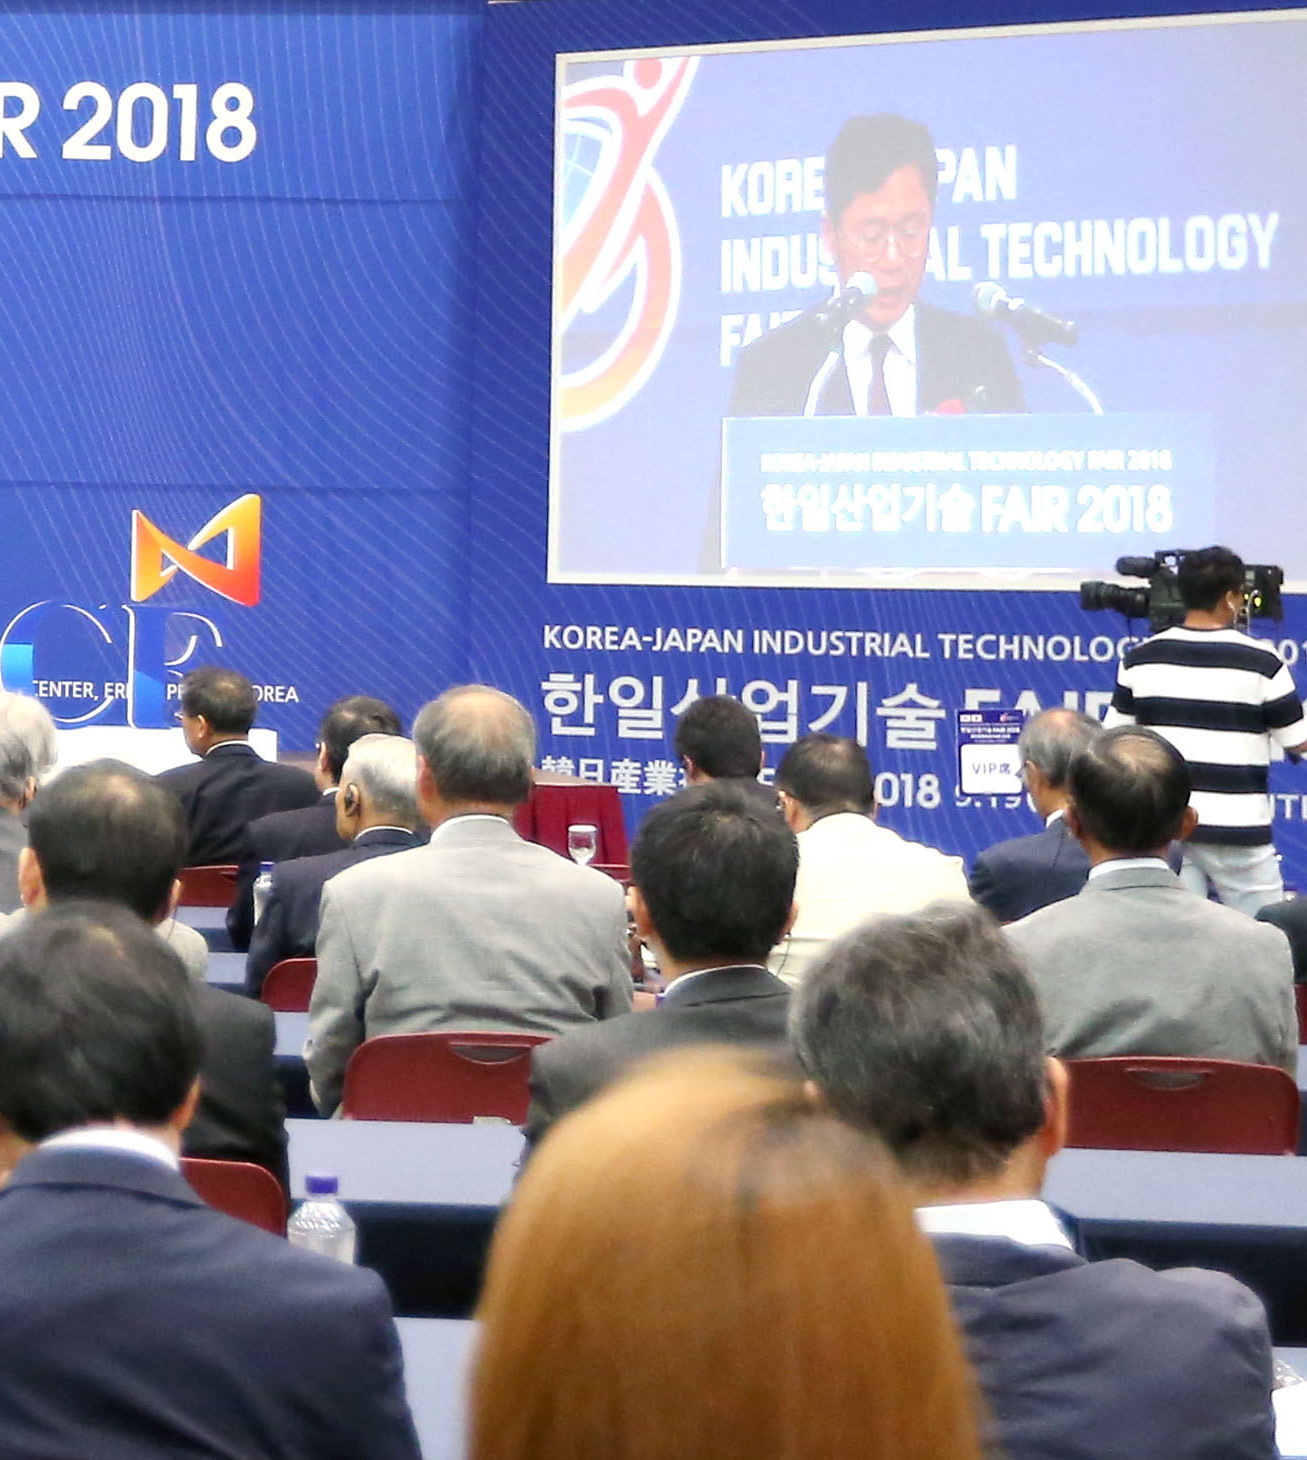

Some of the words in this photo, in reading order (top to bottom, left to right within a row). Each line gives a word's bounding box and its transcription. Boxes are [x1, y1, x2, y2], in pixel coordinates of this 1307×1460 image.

[62, 81, 258, 163] 2018
[980, 212, 1280, 279] TECHNOLOGY
[1127, 448, 1173, 471] 2018
[760, 482, 976, 533] 한일산업기술
[981, 484, 1070, 534] FAIR
[1075, 483, 1174, 534] 2018
[543, 624, 744, 654] KOREA-JAPAN
[753, 629, 931, 659] INDUSTRIAL
